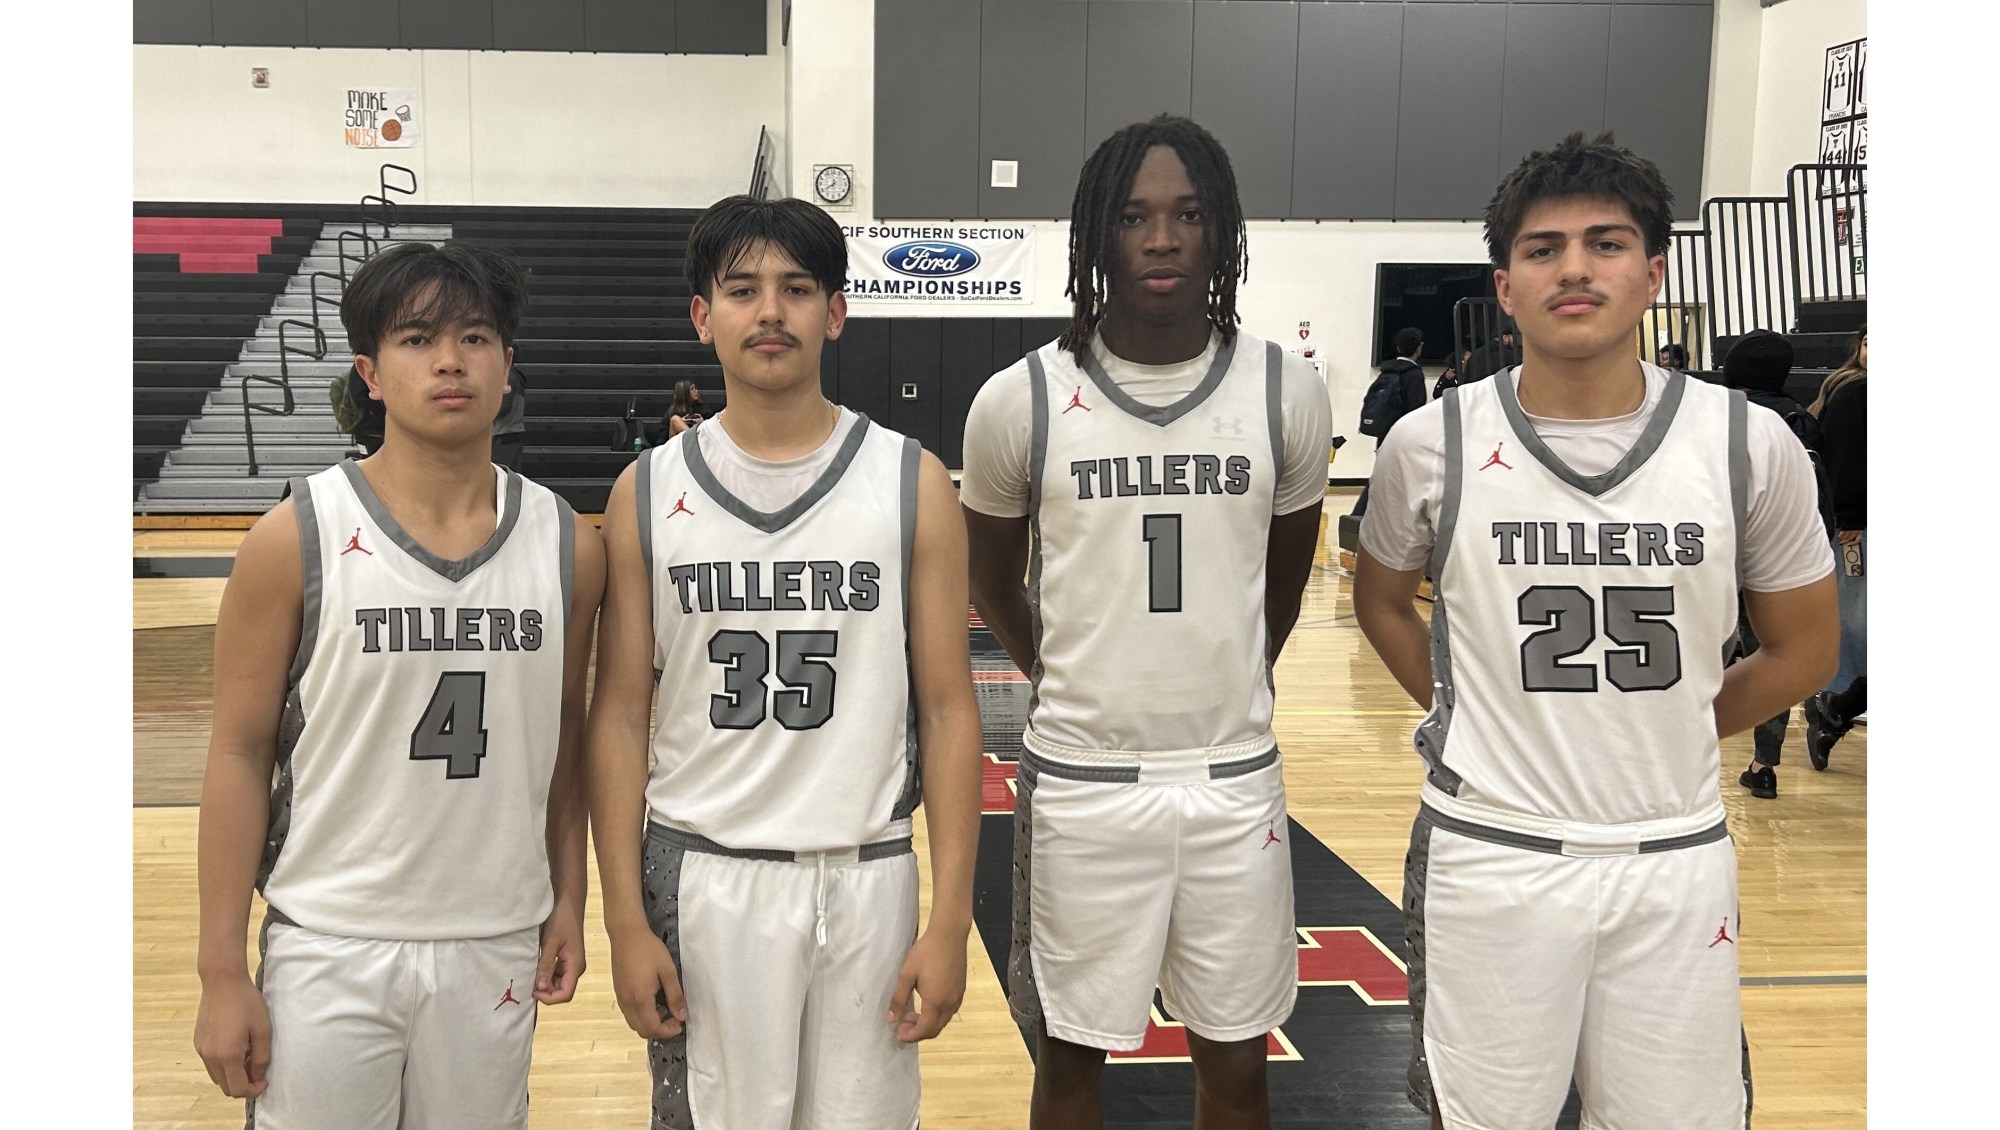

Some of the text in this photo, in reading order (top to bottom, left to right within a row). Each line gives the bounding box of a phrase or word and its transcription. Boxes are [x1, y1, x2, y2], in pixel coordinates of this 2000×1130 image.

[347, 90, 388, 111] MAKE
[1834, 71, 1846, 89] 11
[344, 128, 379, 147] NOISE
[345, 109, 378, 130] SOME
[1828, 111, 1846, 120] FRANCIS
[840, 226, 1024, 240] CIF SOUTHERN SECTION
[902, 245, 961, 272] Ford
[1070, 454, 1251, 500] TILLERS
[1142, 513, 1182, 613] 1
[1491, 521, 1704, 566] TILLERS
[668, 560, 880, 614] TILLERS
[355, 607, 543, 653] TILLERS
[1517, 585, 1682, 692] 25
[707, 629, 839, 730] 35
[409, 670, 488, 779] 4
